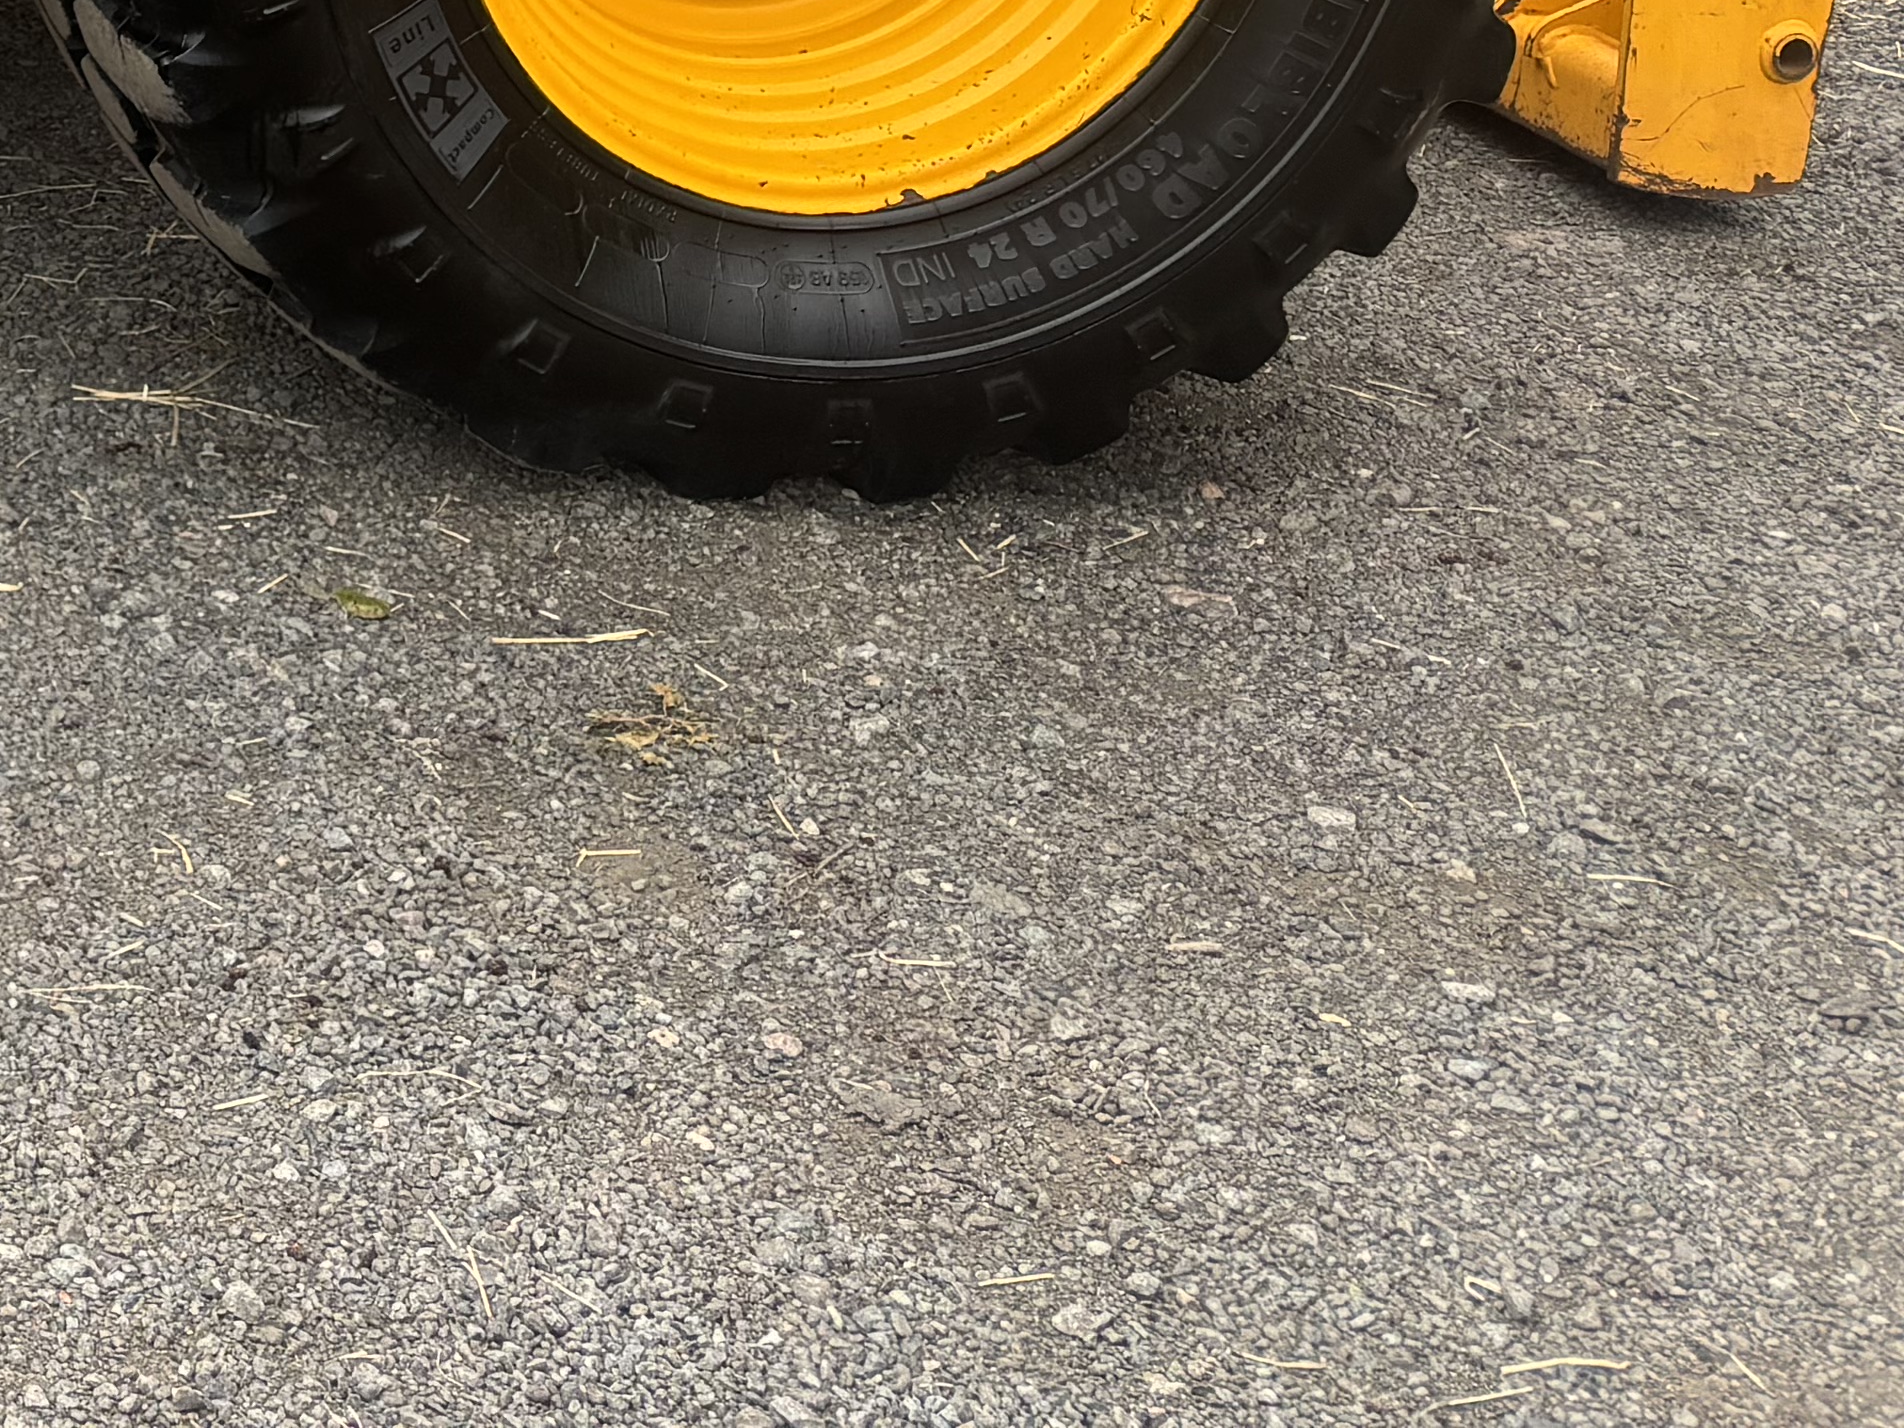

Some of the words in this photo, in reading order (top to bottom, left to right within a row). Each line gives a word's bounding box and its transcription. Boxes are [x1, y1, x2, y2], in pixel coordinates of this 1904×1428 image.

[388, 15, 436, 54] Line
[447, 107, 495, 163] Compact
[1059, 130, 1185, 230] 460/70
[966, 232, 1020, 271] 24
[1018, 216, 1058, 248] R
[1048, 217, 1142, 281] HARD
[892, 251, 957, 289] IND
[902, 265, 1048, 326] SURFACE
